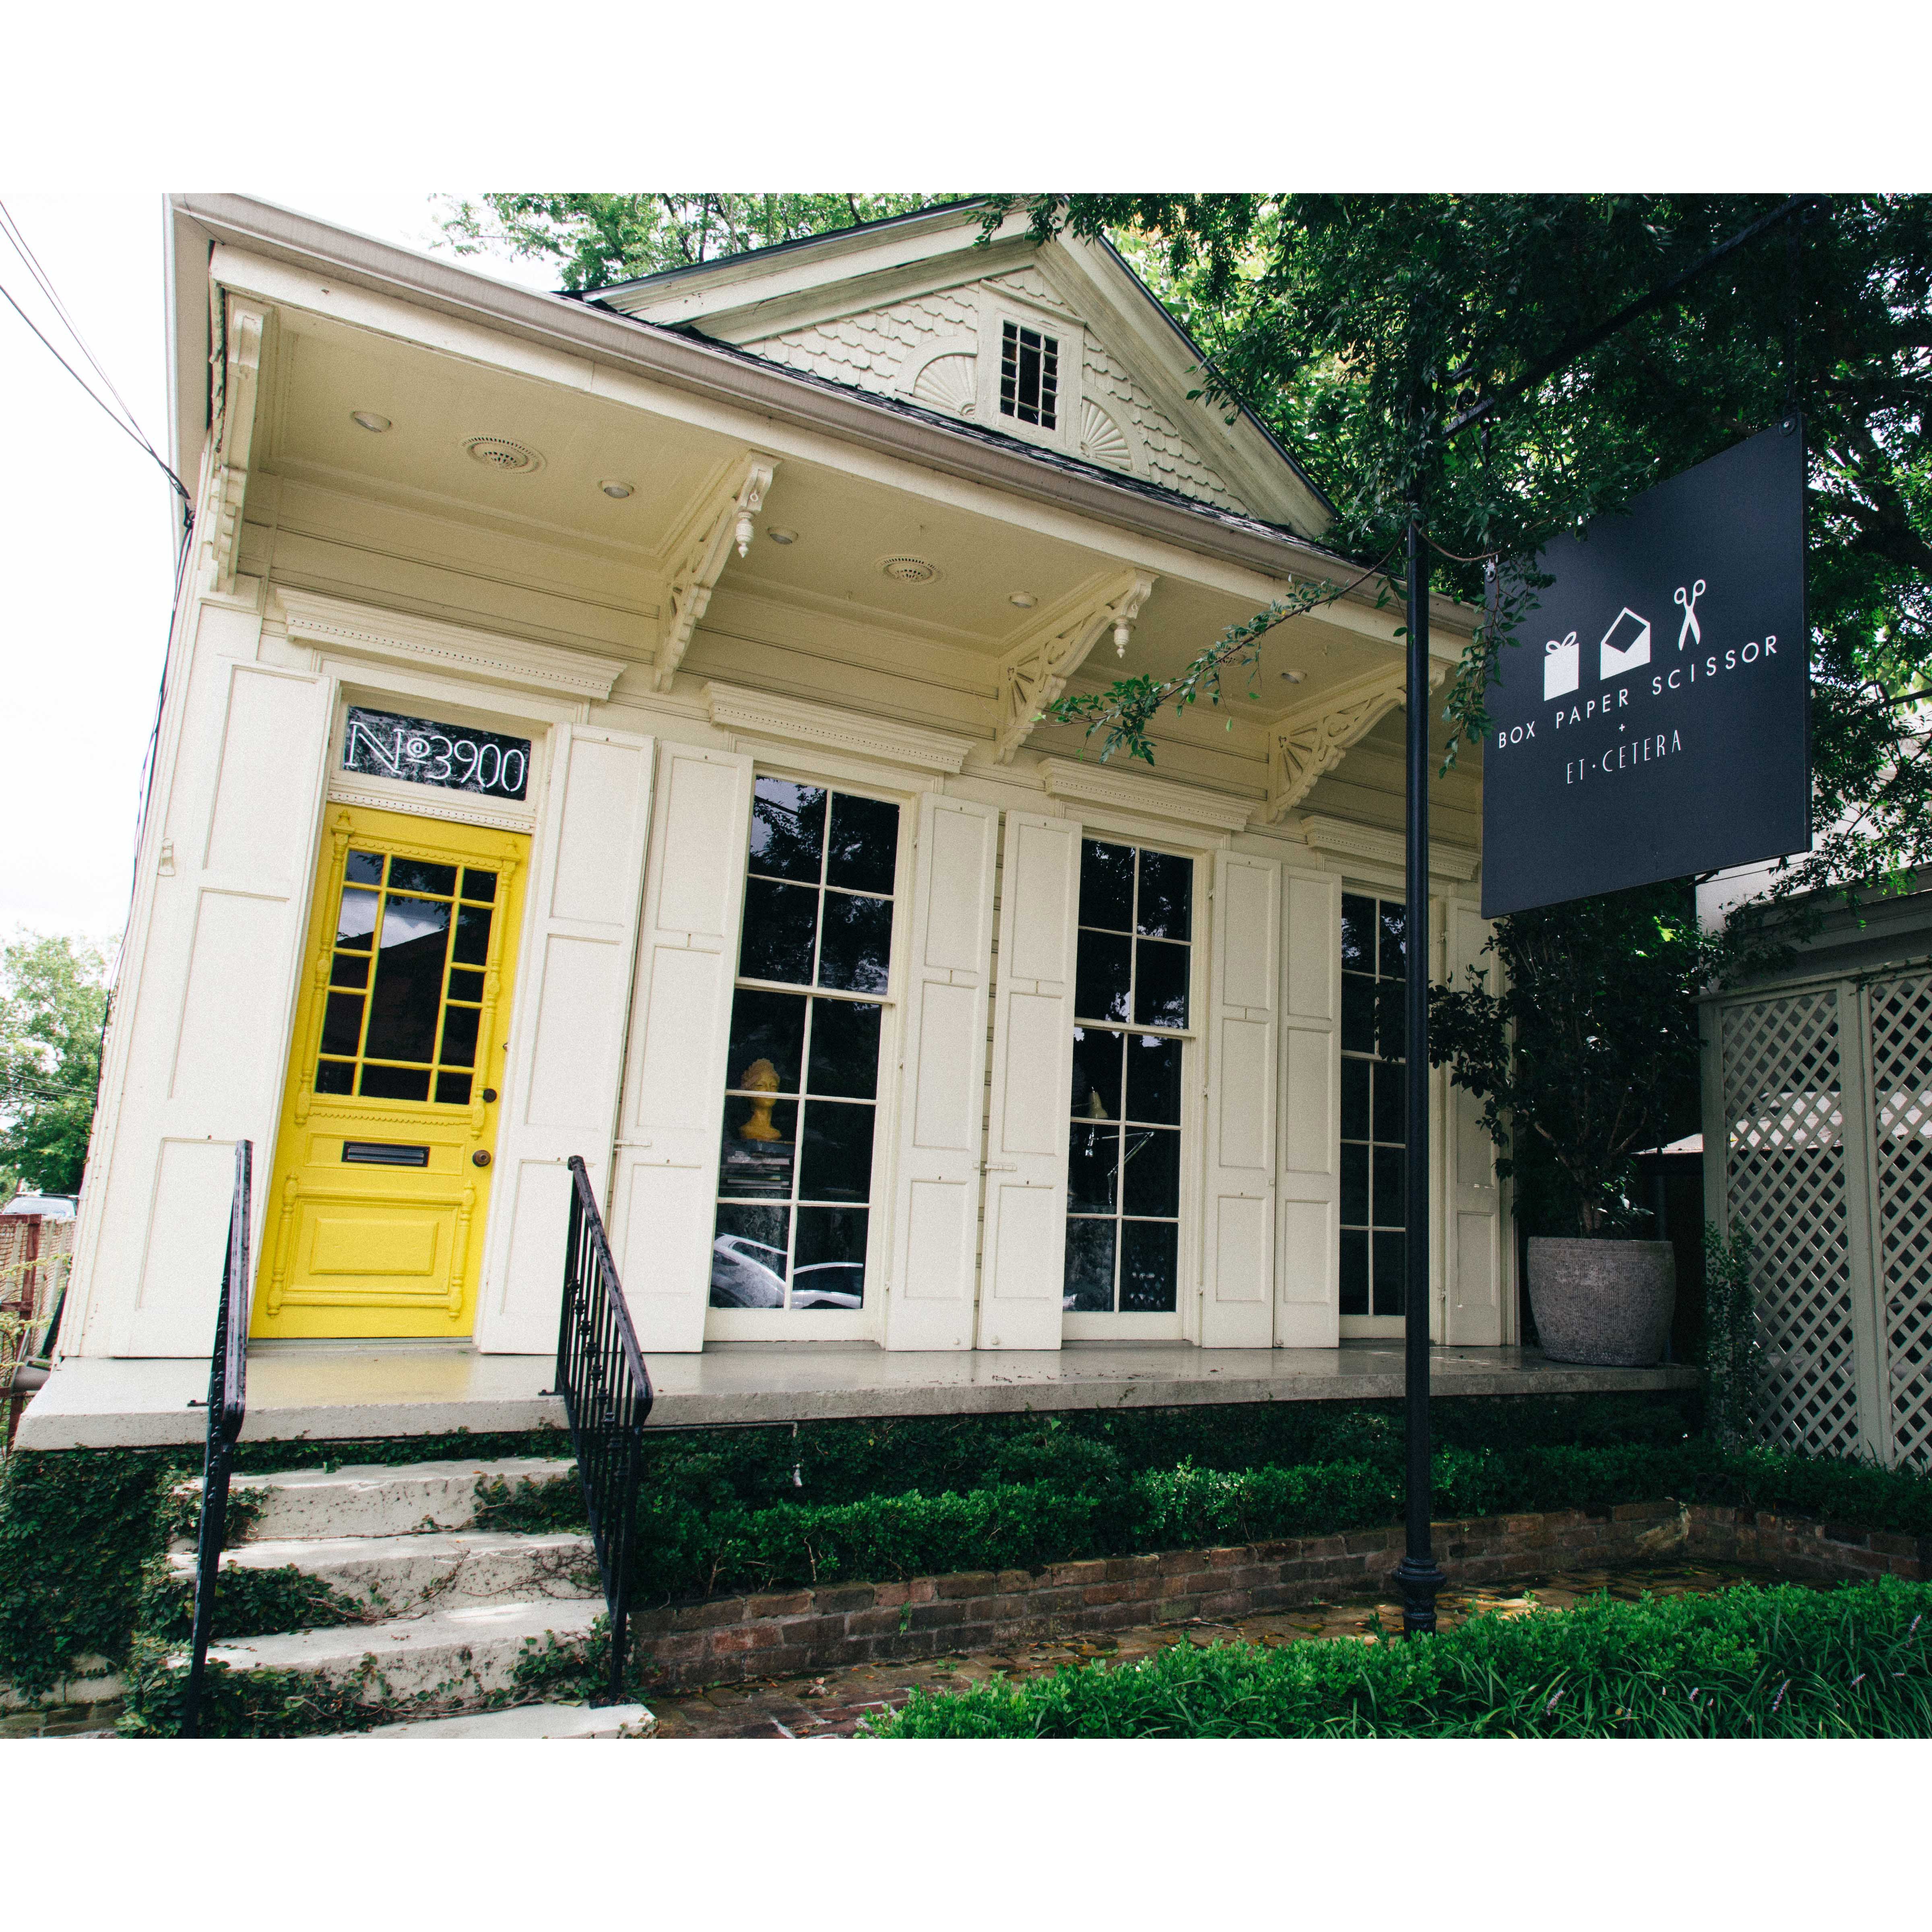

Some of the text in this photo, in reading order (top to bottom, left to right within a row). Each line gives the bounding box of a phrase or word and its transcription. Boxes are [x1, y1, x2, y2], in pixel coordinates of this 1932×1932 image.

[1499, 635, 1777, 749] BOX PAPER SCISSOR
